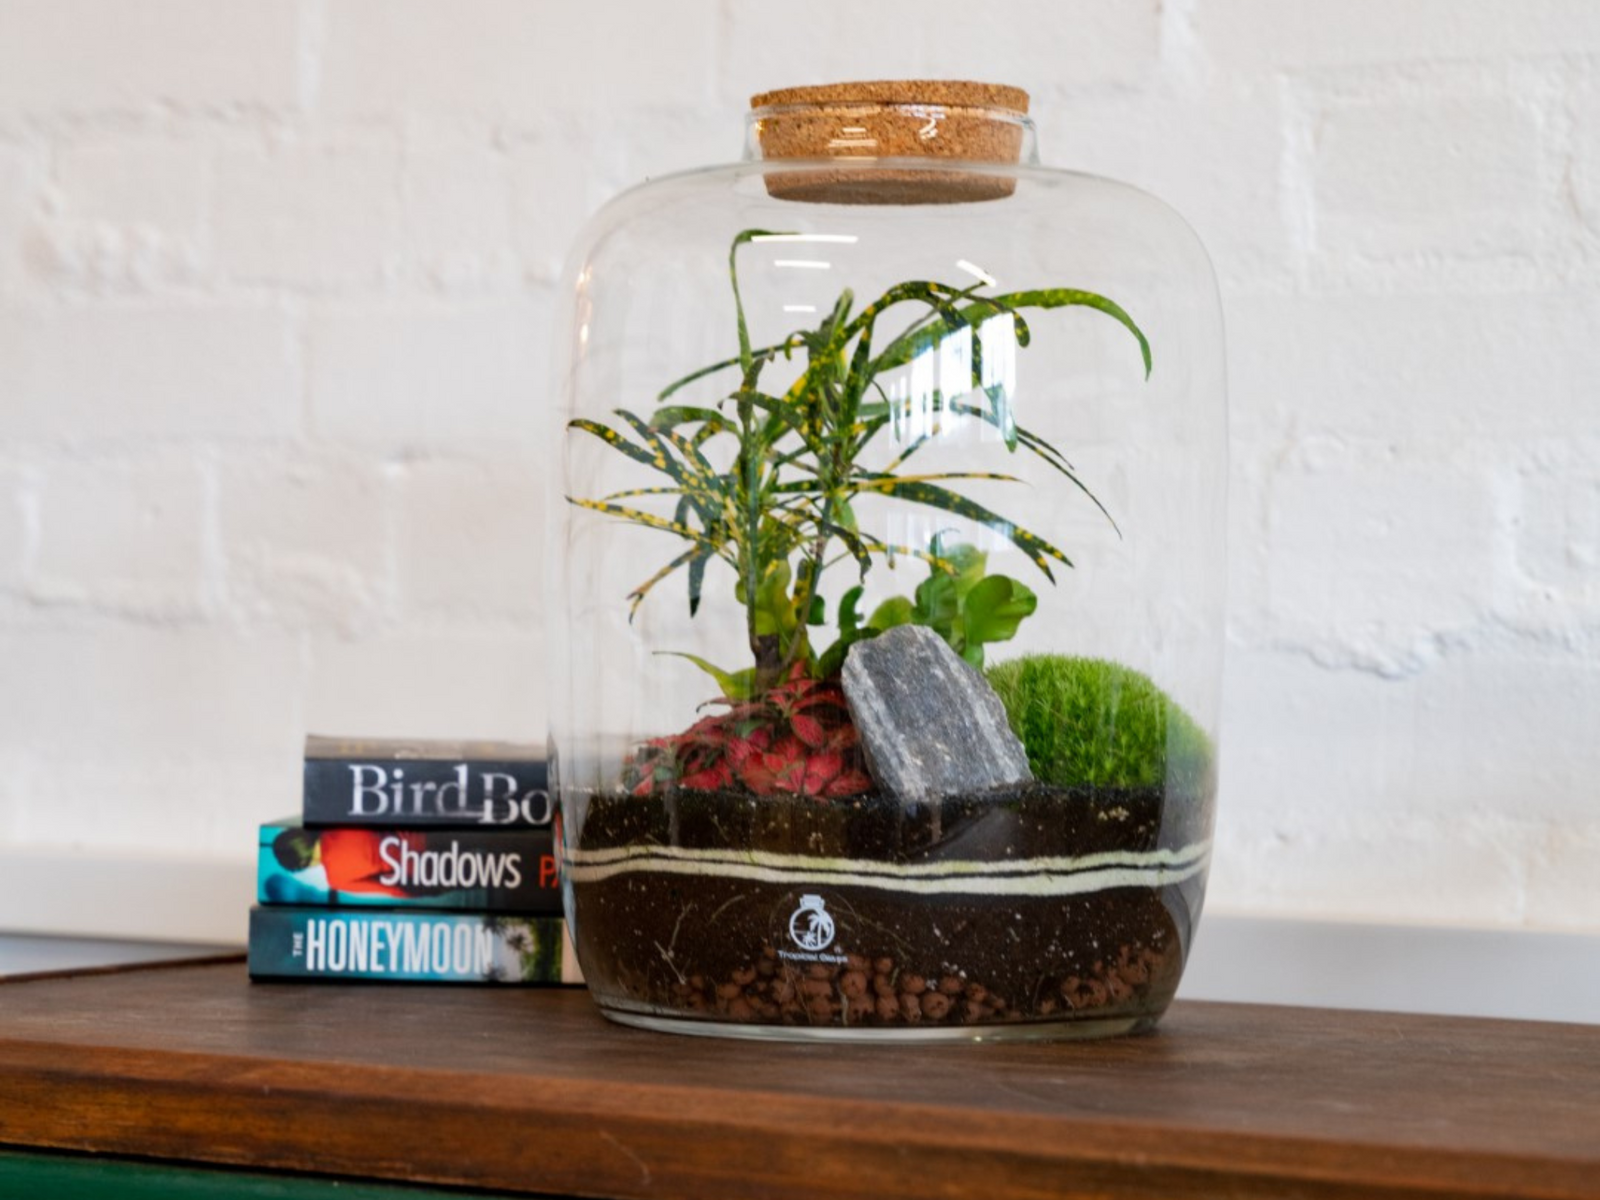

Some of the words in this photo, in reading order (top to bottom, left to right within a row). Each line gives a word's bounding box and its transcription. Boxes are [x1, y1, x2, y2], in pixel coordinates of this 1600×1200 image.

[347, 763, 469, 817] Bird
[379, 836, 522, 888] Shadows
[292, 932, 304, 957] THE
[306, 918, 494, 975] HONEYMOON
